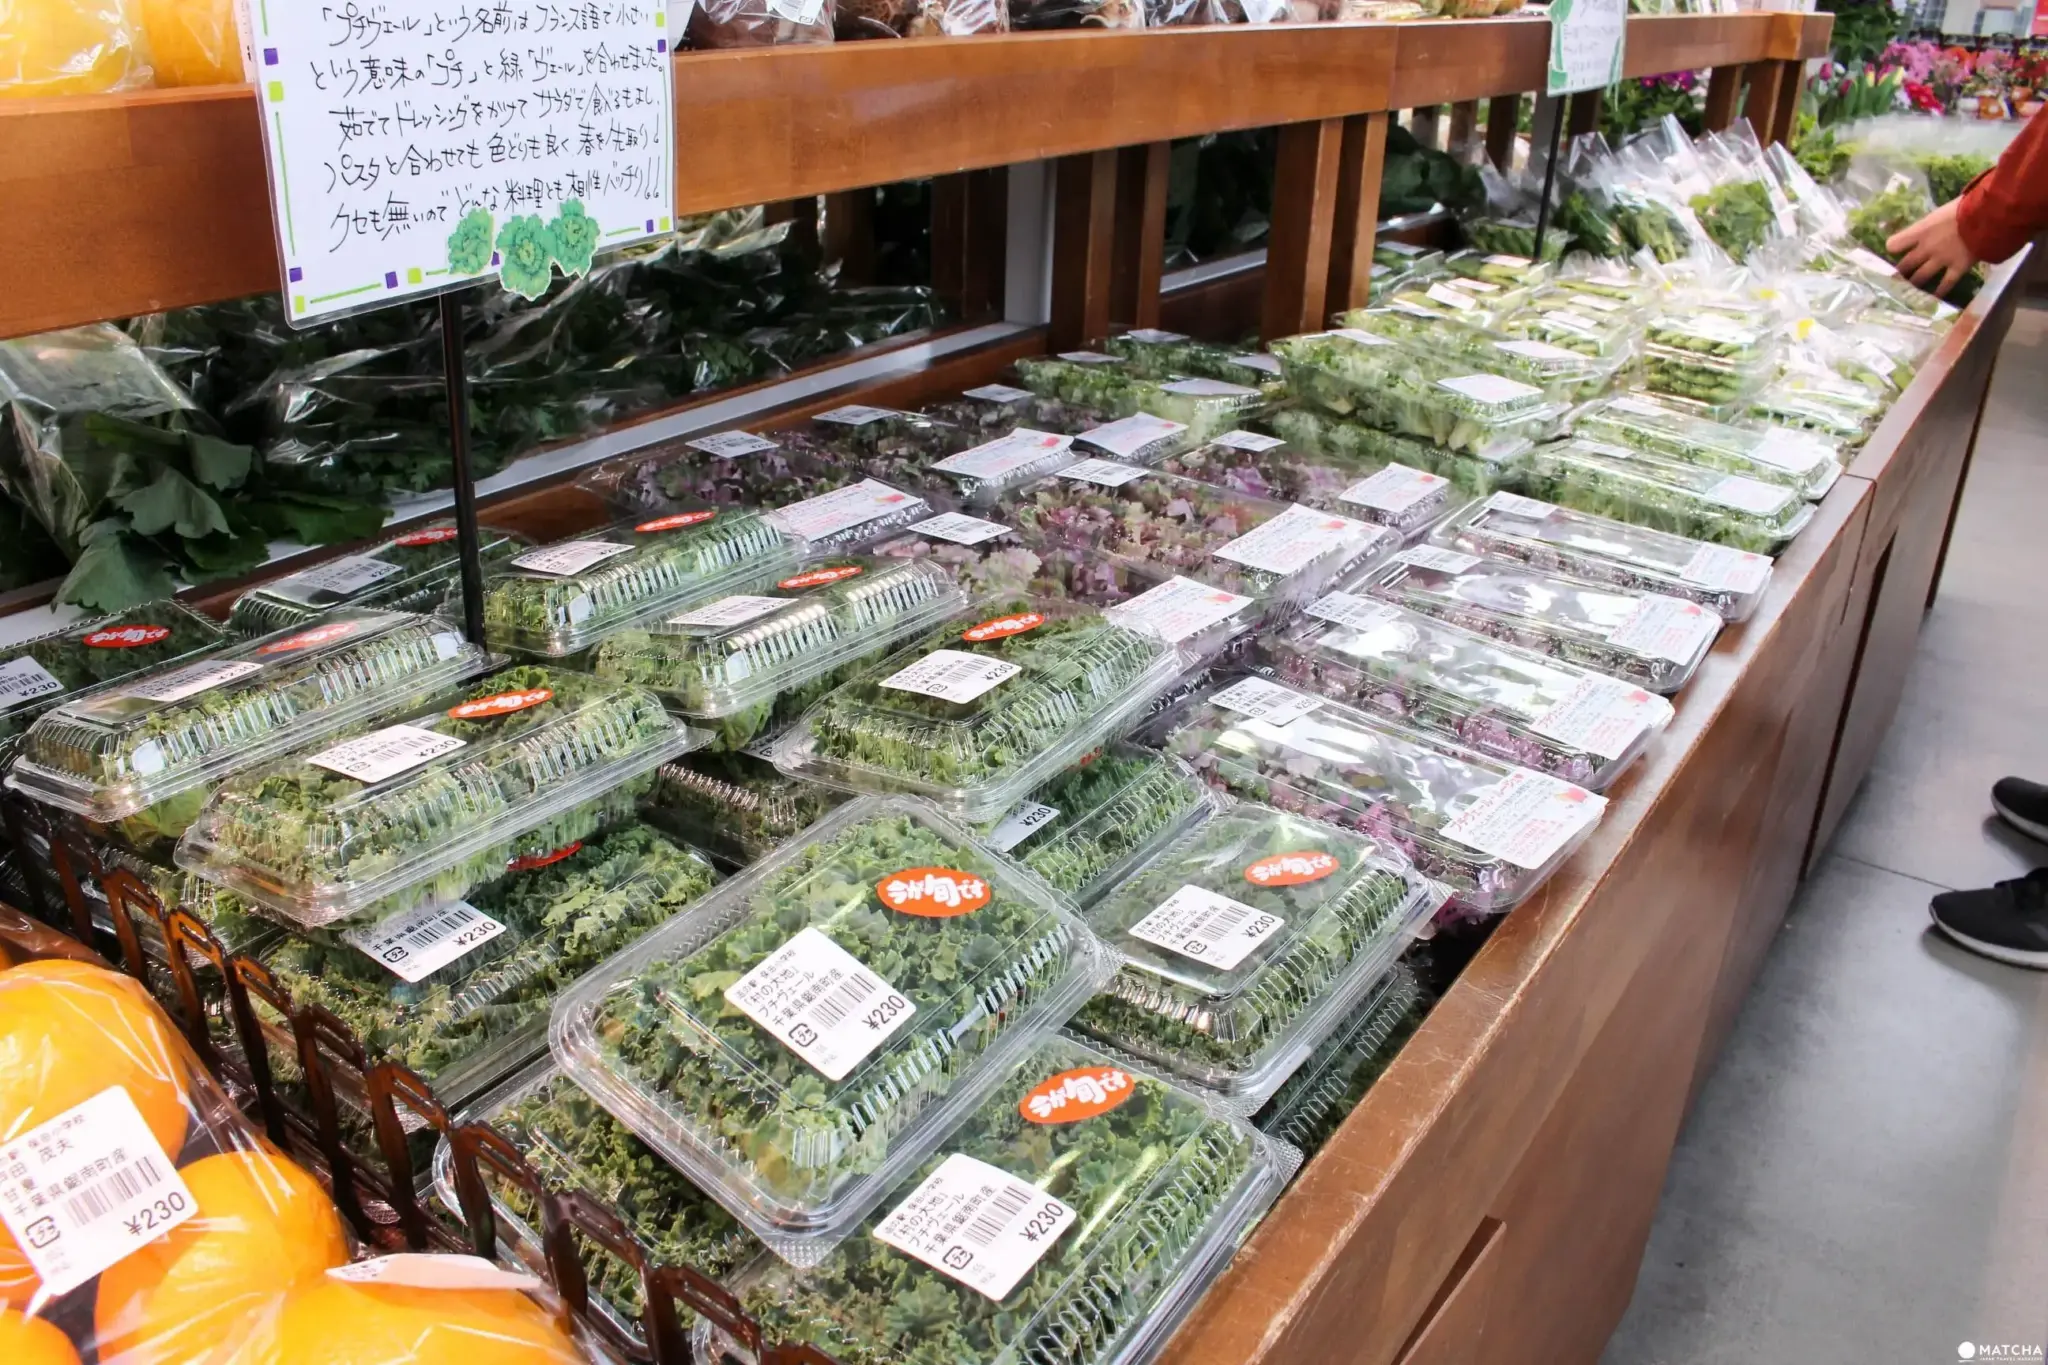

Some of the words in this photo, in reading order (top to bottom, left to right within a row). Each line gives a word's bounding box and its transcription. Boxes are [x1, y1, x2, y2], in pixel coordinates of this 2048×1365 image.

[982, 664, 1014, 681] ¥230
[18, 682, 57, 696] ¥230
[417, 740, 458, 757] ¥230
[1019, 807, 1051, 827] ¥230
[1251, 856, 1333, 882] 今が旬です
[886, 873, 985, 908] 今が旬です
[453, 921, 497, 947] ¥230
[1241, 915, 1276, 939] ¥230
[862, 994, 905, 1031] ¥230
[1027, 1070, 1127, 1117] 今が旬です
[14, 1147, 127, 1217] 千葉県鋸南町産
[123, 1191, 186, 1236] ¥230
[1019, 1202, 1063, 1242] ¥230
